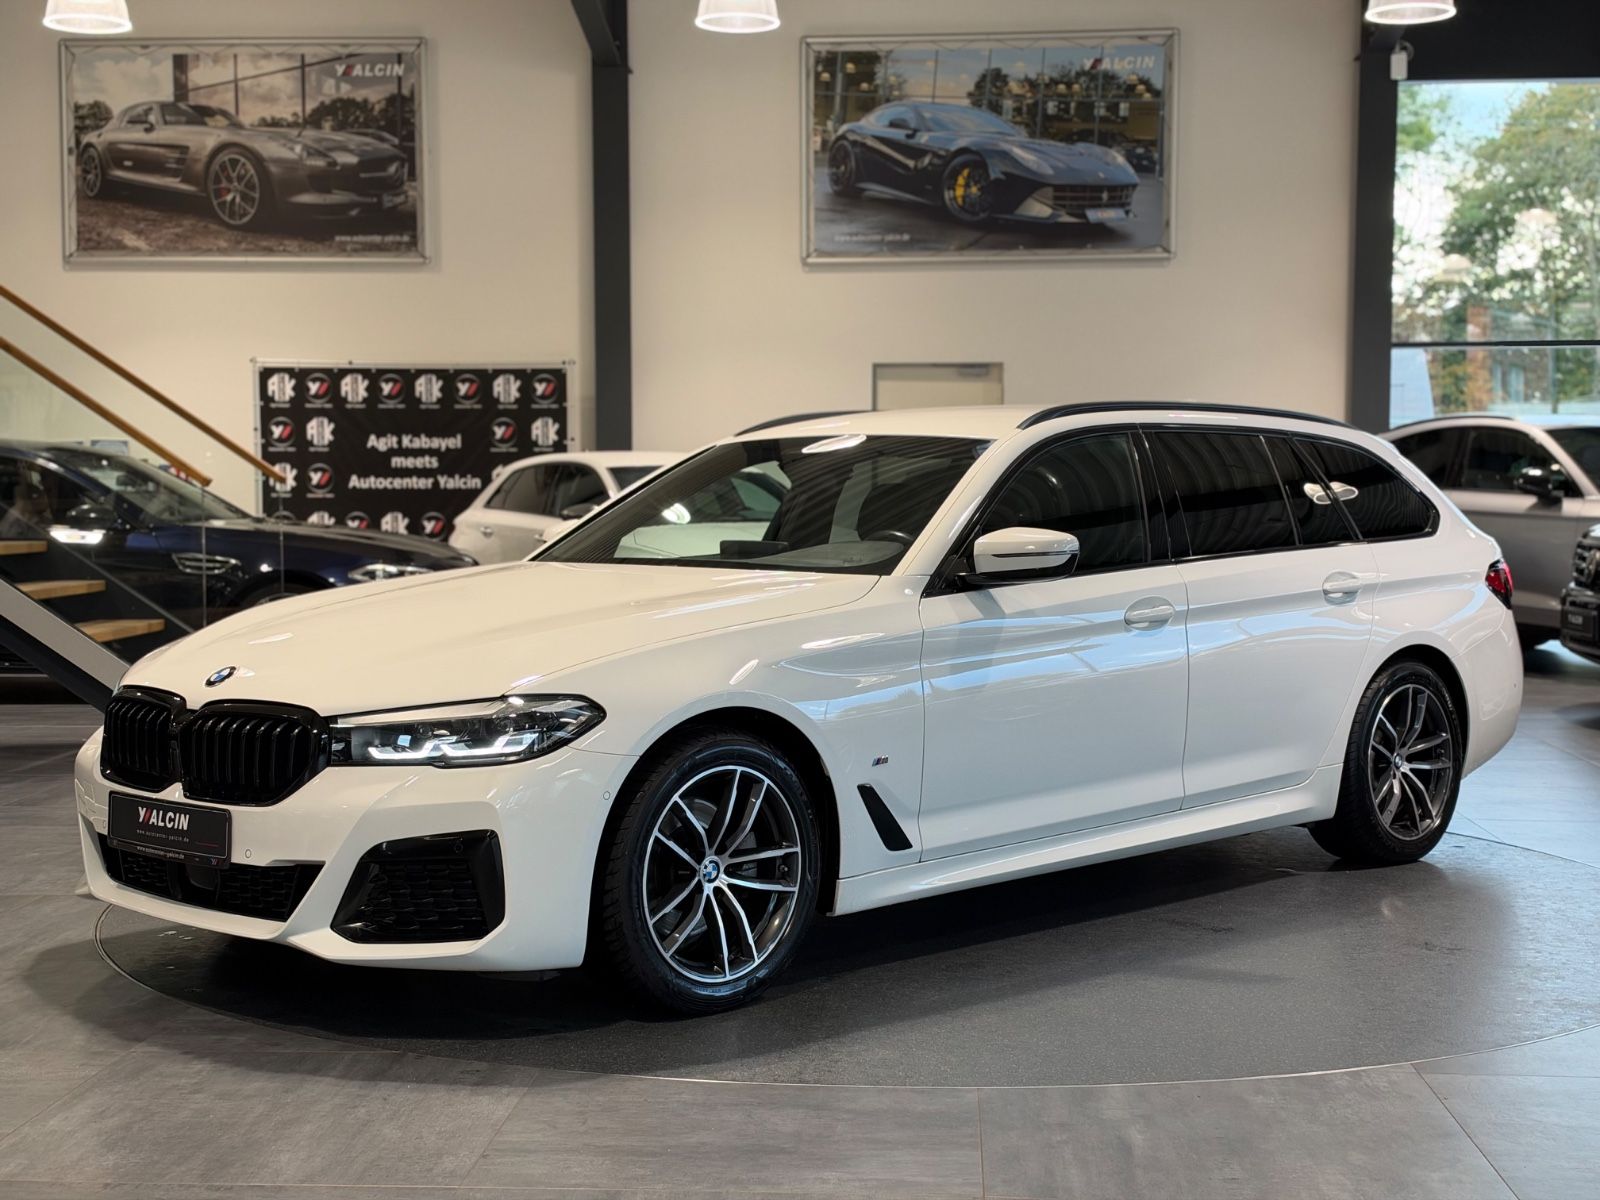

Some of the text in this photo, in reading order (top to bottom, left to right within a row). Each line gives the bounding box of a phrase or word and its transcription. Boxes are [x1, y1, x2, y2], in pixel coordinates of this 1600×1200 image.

[366, 433, 462, 452] Agit Kabayel
[390, 454, 439, 469] meets
[348, 473, 482, 490] Autocenter Yalcin
